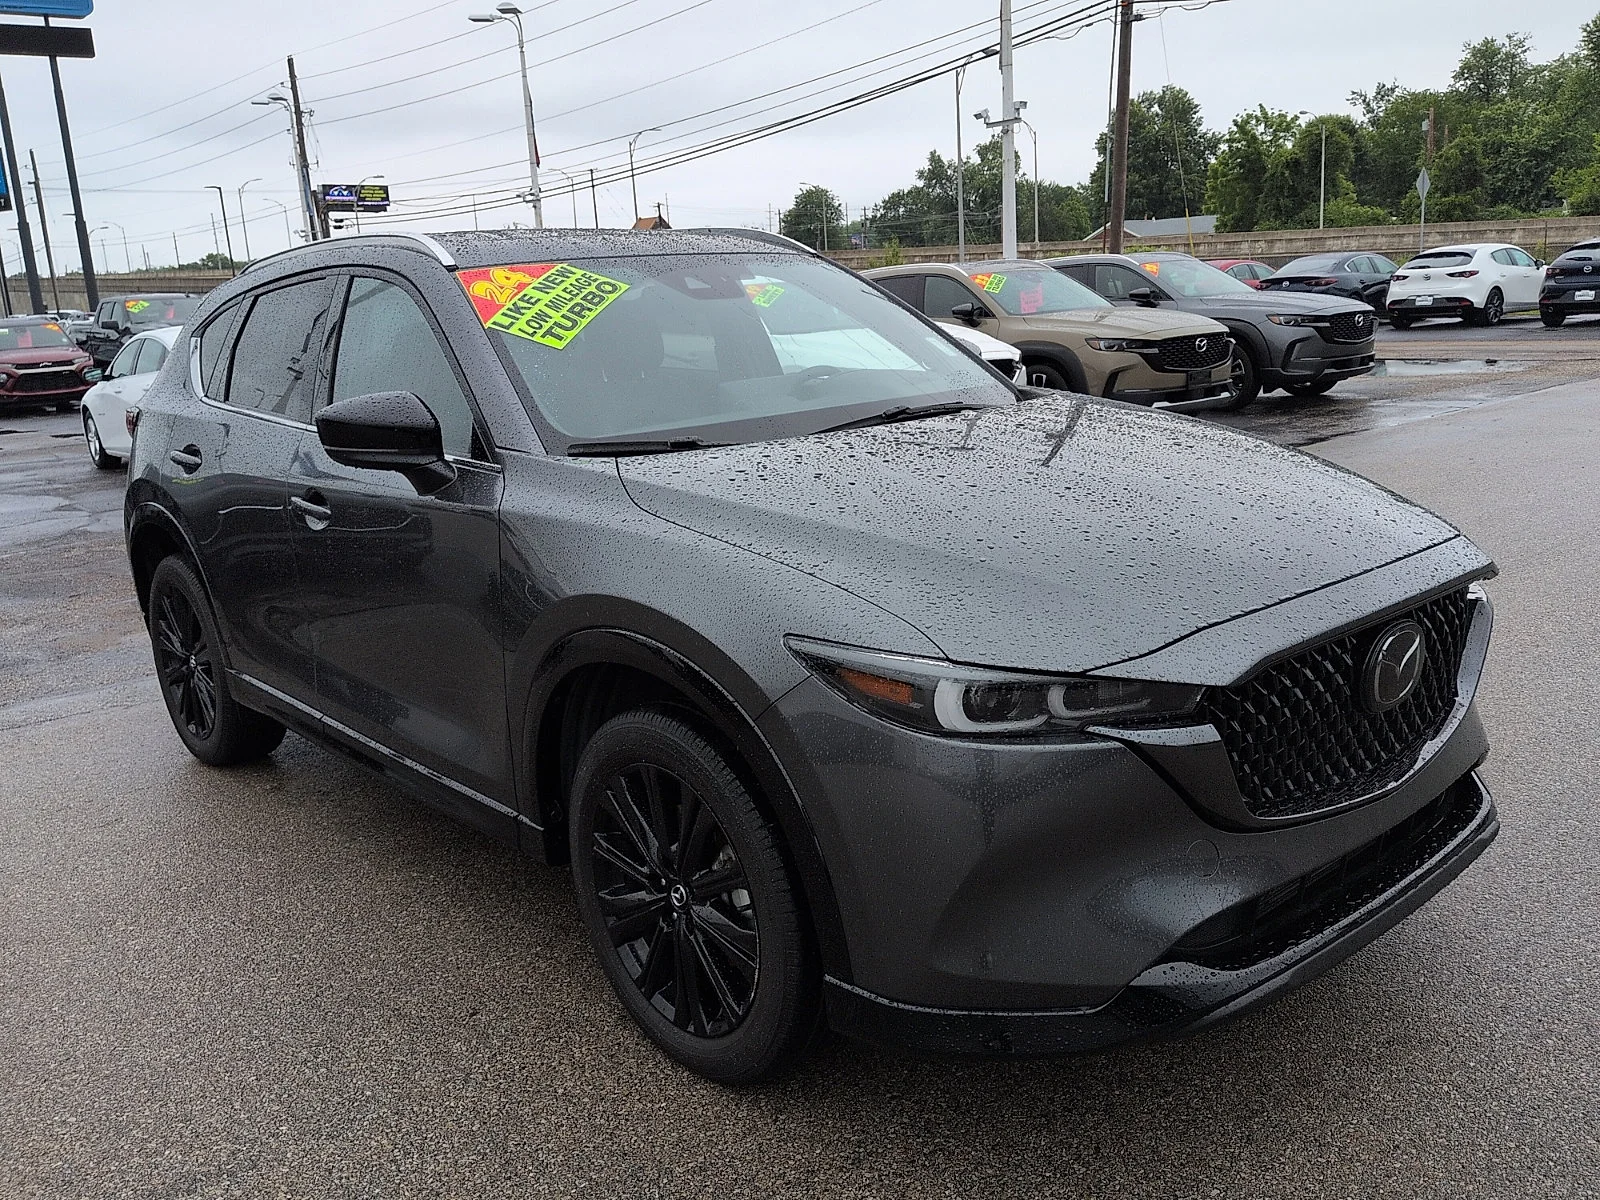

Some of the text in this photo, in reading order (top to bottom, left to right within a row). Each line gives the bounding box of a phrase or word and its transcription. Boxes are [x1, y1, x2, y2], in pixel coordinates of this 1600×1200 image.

[469, 268, 536, 304] 24
[491, 265, 576, 330] LIKE NEW
[518, 272, 599, 338] LOW MILEAGE
[540, 280, 622, 342] TURBO
